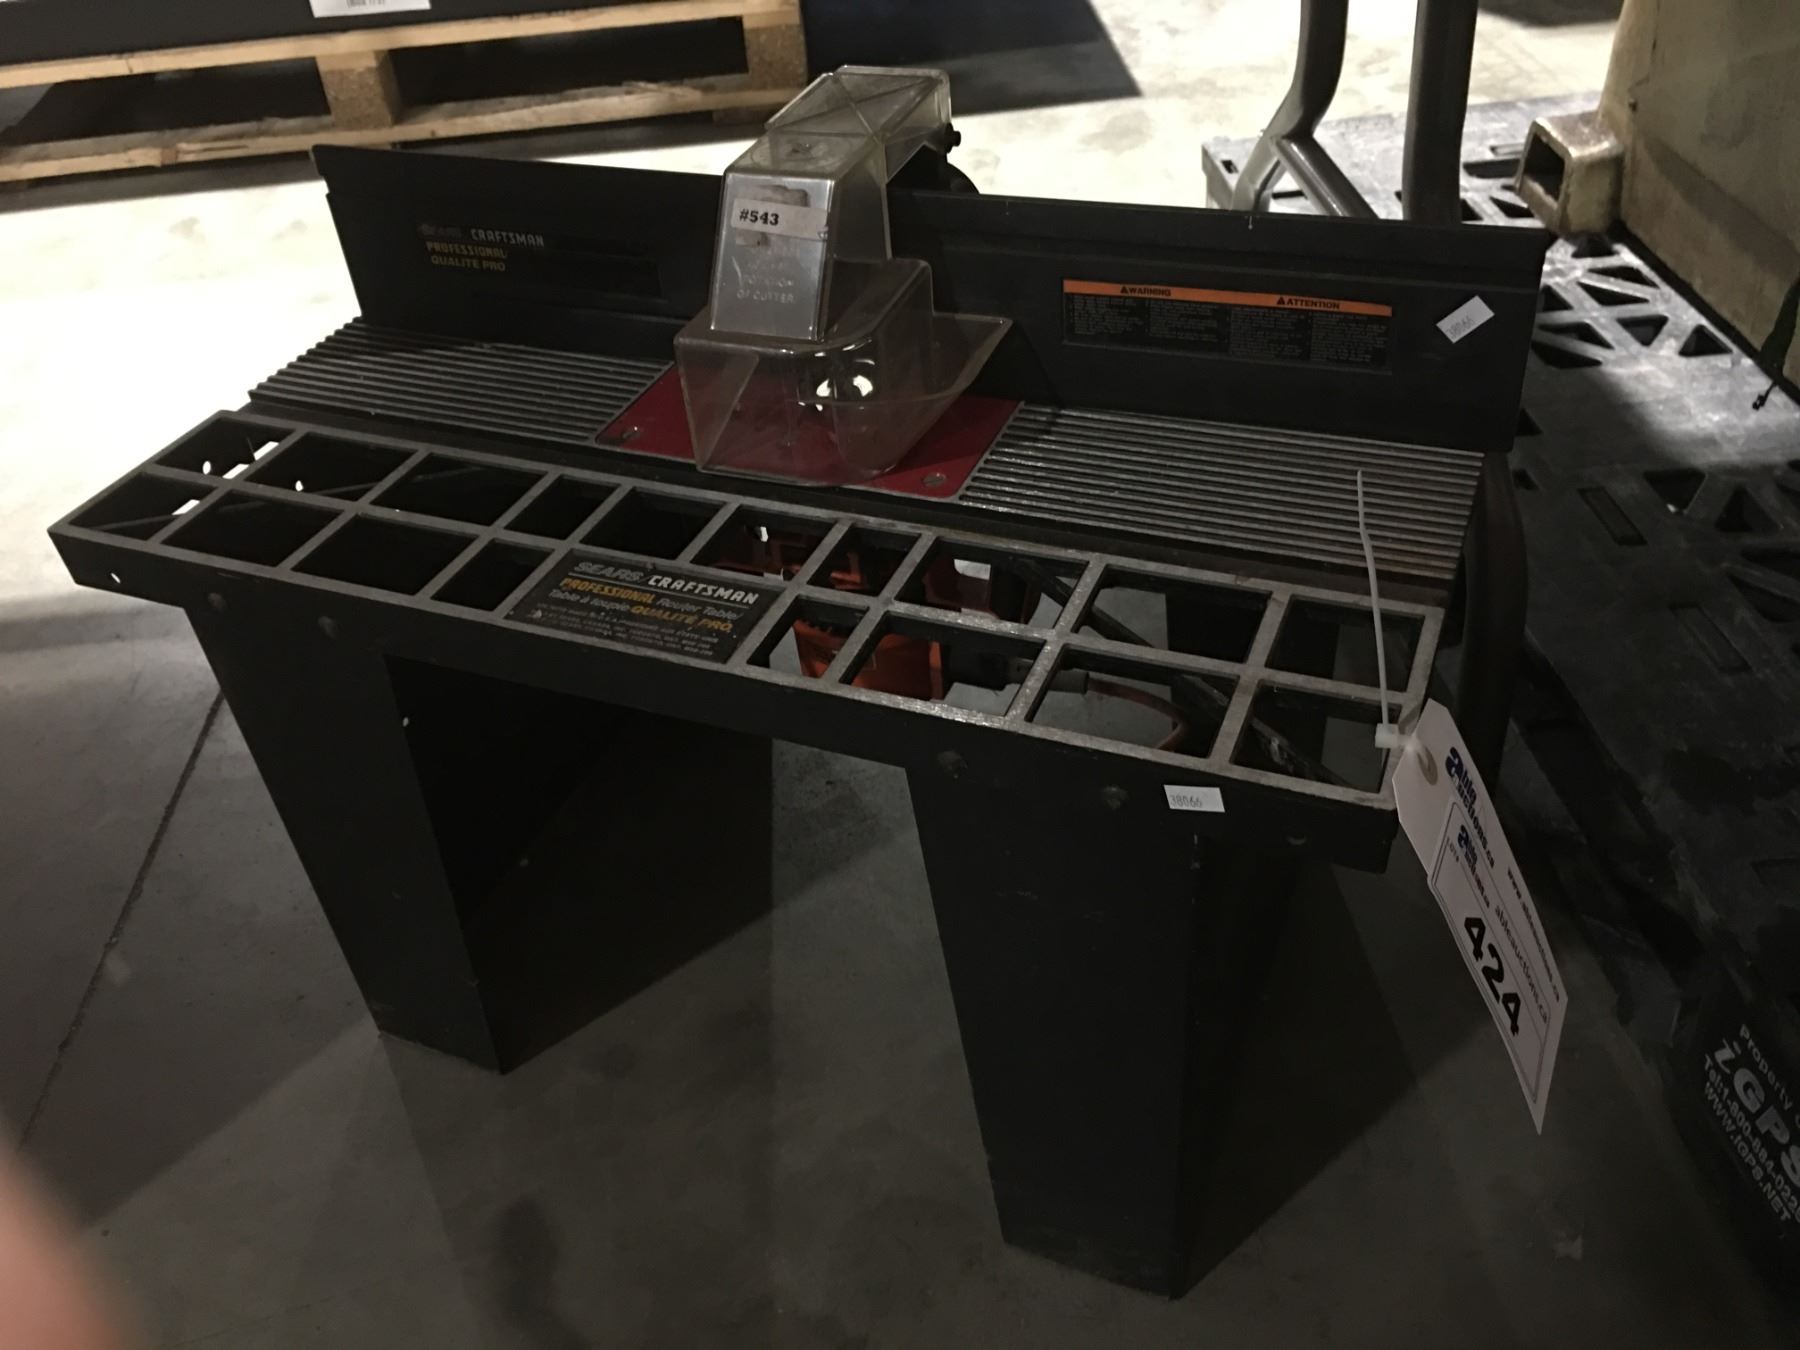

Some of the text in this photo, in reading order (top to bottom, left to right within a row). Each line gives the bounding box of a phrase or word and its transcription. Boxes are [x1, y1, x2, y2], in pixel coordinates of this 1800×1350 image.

[739, 209, 779, 226] #543
[470, 228, 544, 248] CRAFTSMAN
[426, 241, 507, 259] PROFESSIONAL
[482, 260, 506, 272] PRO
[1130, 287, 1171, 297] WARNING
[1287, 298, 1340, 310] ATTENTION
[549, 588, 580, 602] Table
[559, 577, 656, 605] PROFESSIONAL
[656, 597, 700, 613] Router
[648, 575, 760, 605] CRAFTSMAN
[1464, 917, 1521, 1037] 424
[1740, 1024, 1793, 1111] Property
